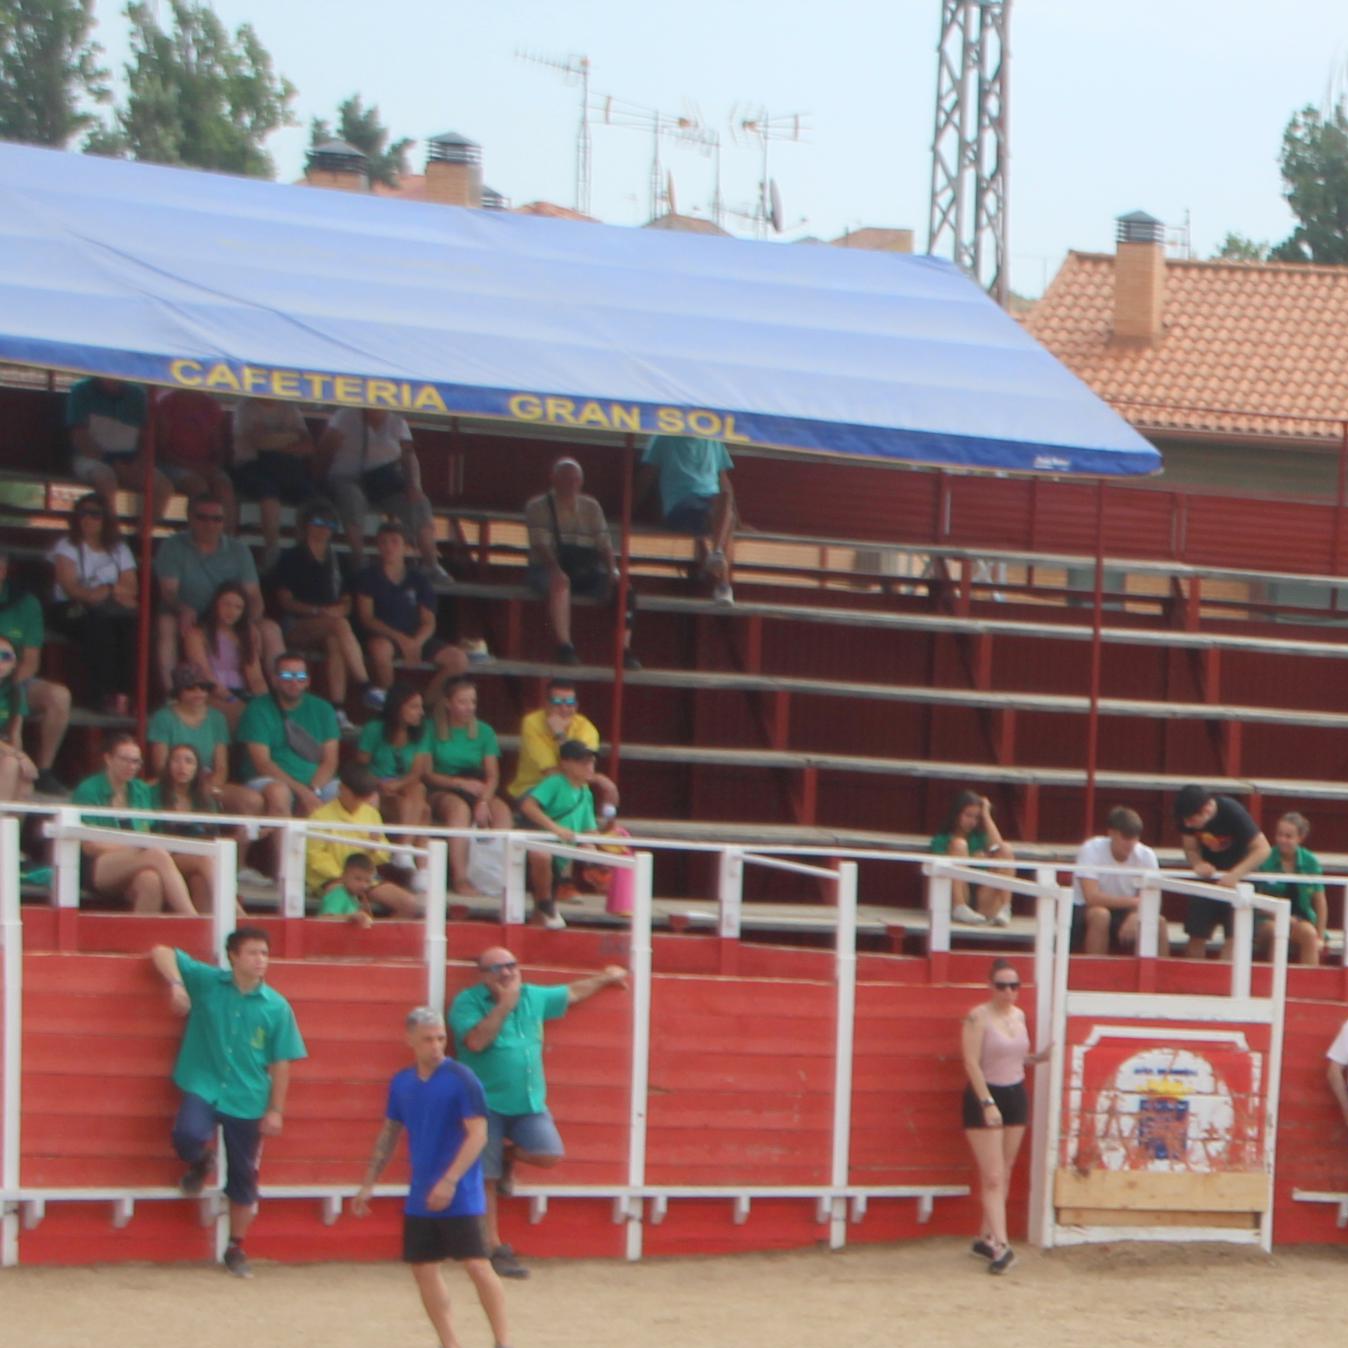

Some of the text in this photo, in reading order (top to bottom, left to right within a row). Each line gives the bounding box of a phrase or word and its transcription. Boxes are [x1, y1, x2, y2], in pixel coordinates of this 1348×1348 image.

[170, 359, 751, 443] CAFETERIA GRAN SOL
